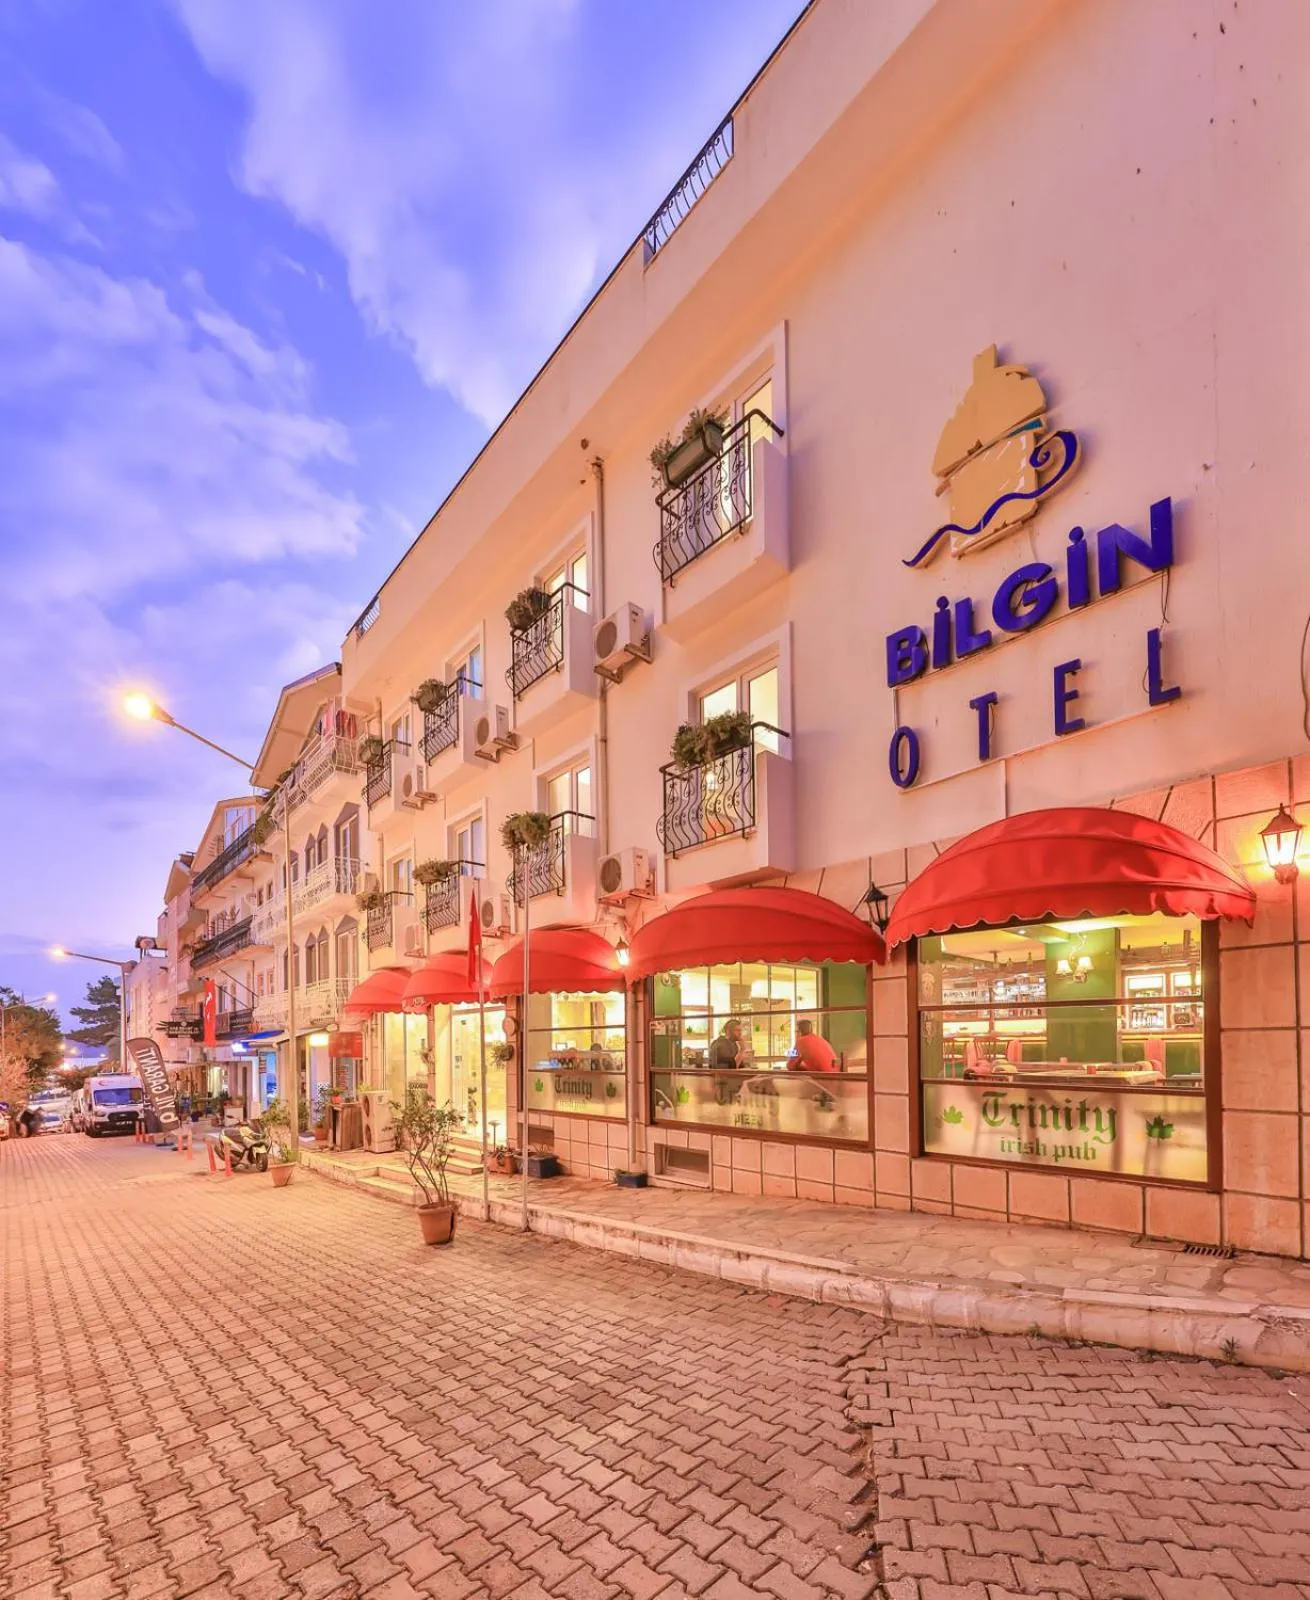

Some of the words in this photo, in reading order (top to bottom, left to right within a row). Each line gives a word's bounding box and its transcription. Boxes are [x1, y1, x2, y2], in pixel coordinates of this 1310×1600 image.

[887, 496, 1173, 687] BİLGİN
[889, 628, 1182, 788] OTEL
[555, 1074, 592, 1100] Trinity
[982, 1091, 1117, 1144] Trinity
[1000, 1137, 1047, 1156] irish
[1053, 1141, 1096, 1162] pub
